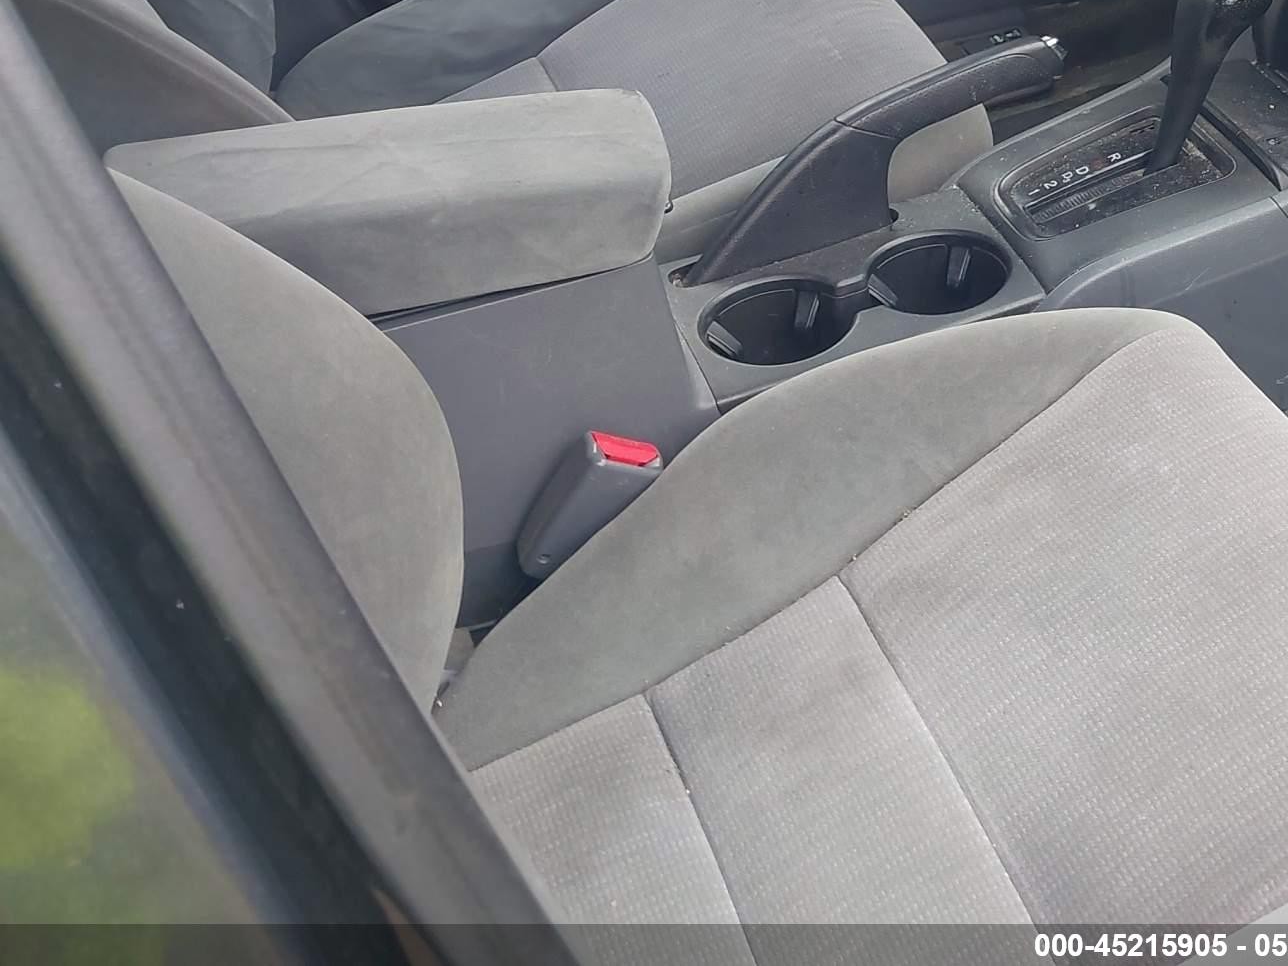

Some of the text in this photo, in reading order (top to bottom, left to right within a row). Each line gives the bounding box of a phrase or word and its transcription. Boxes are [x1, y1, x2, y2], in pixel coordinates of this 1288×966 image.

[1107, 152, 1121, 162] R
[1075, 165, 1089, 175] D
[1043, 180, 1058, 189] 2
